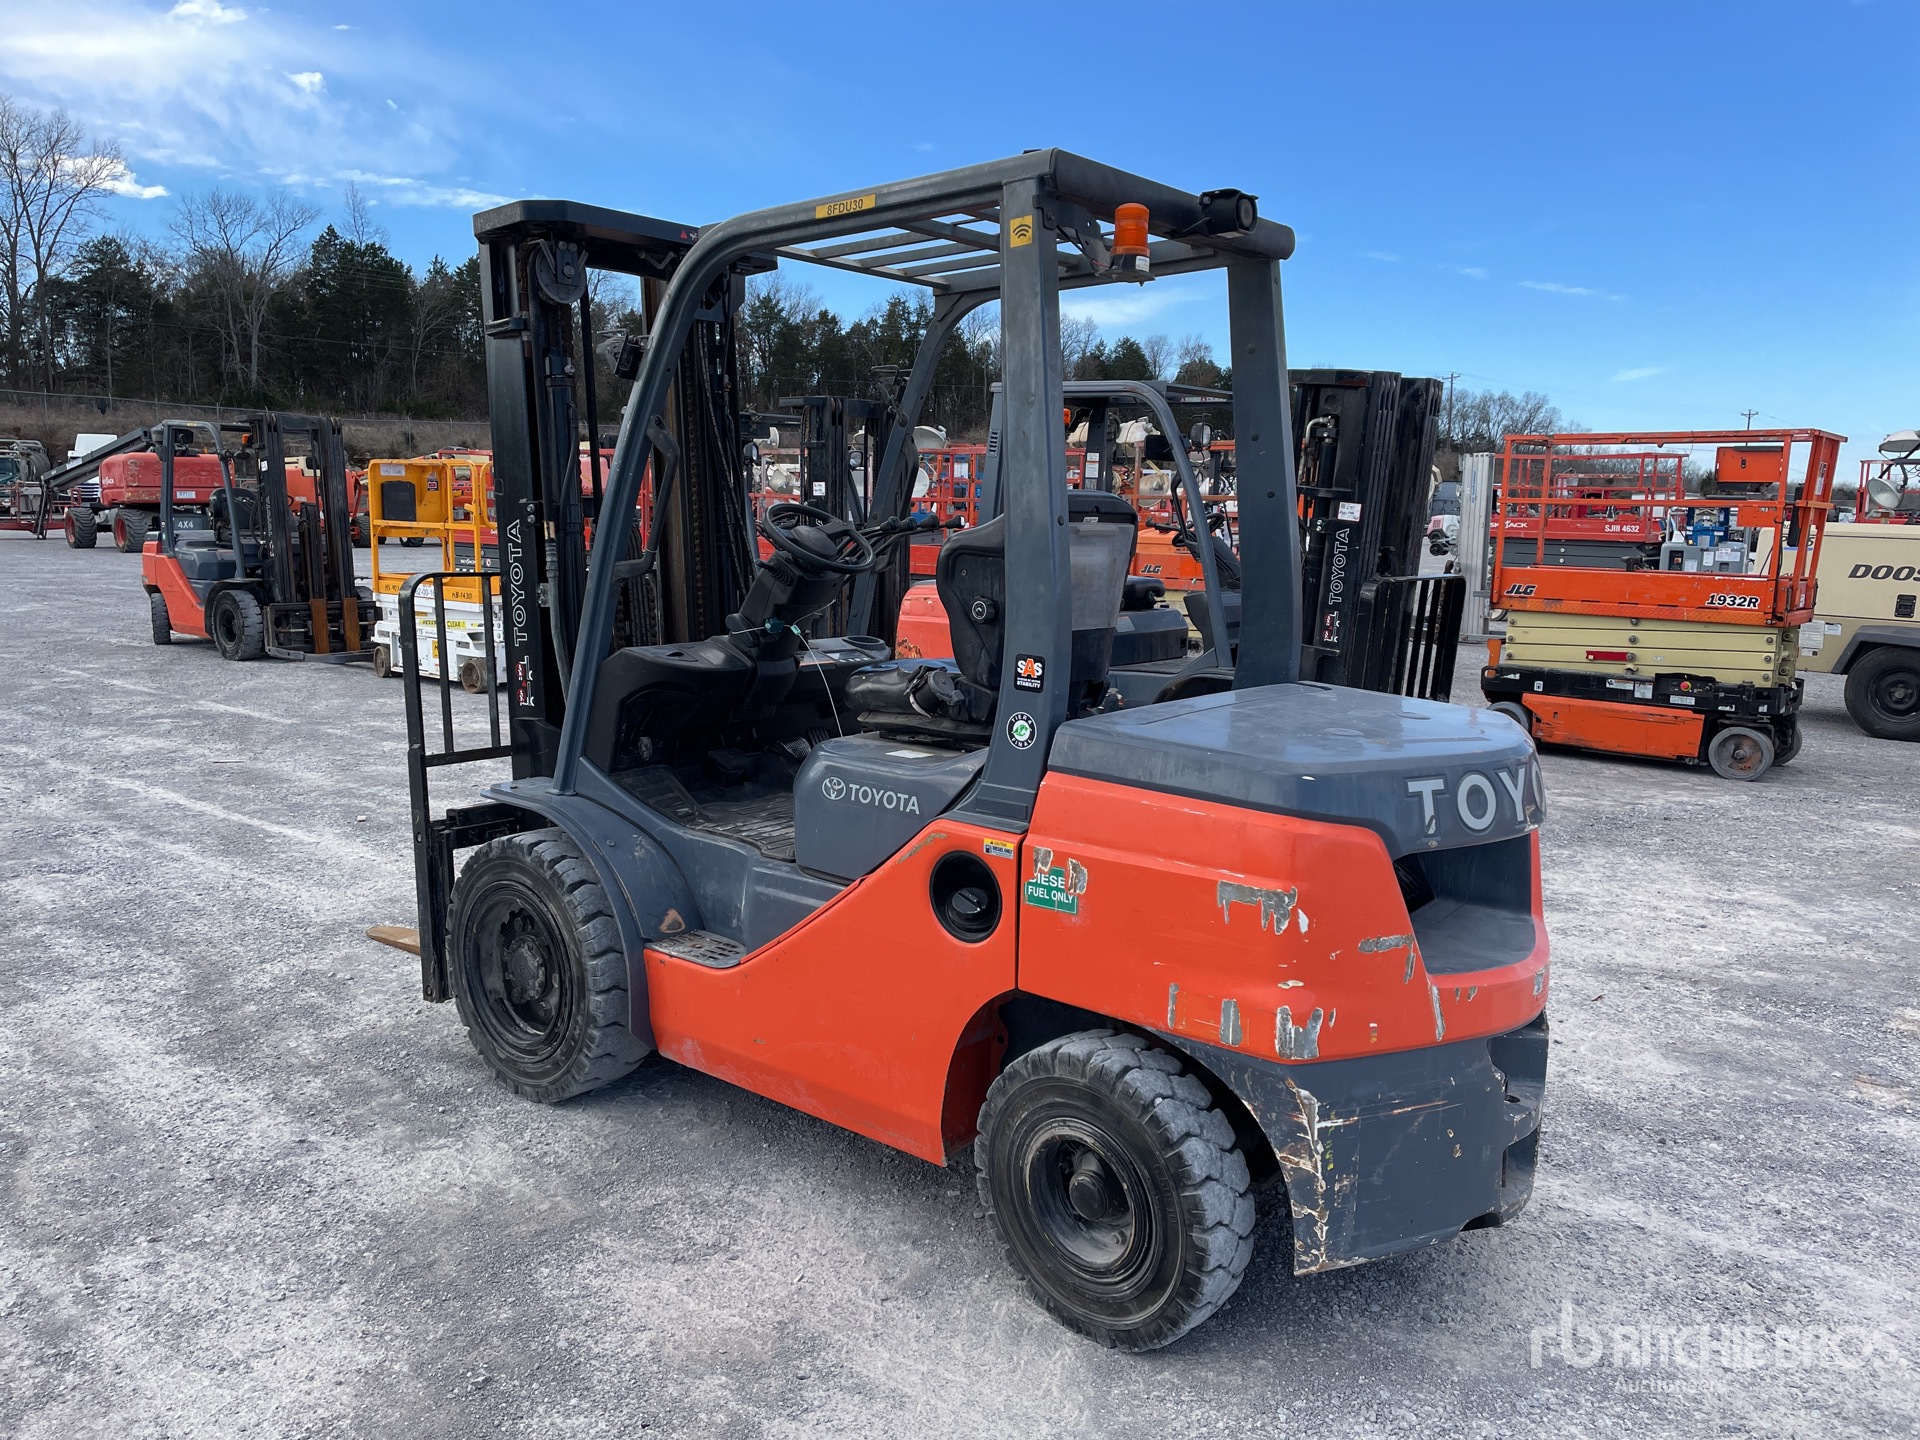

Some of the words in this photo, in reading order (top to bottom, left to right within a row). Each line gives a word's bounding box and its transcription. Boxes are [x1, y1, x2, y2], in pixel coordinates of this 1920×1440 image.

[826, 198, 864, 216] 8FDU30
[177, 520, 194, 529] 4X4
[1621, 524, 1640, 533] 4632
[1141, 563, 1162, 575] JLG
[1328, 527, 1350, 606] TOYOTA
[506, 518, 528, 647] TOYOTA
[1504, 583, 1539, 597] JLG
[1705, 592, 1760, 610] 1932R
[1016, 658, 1043, 679] SAS
[1011, 713, 1028, 723] TIER
[1011, 737, 1033, 748] FINAL
[848, 783, 920, 815] TOYOTA
[1028, 885, 1050, 900] FUEL
[1051, 890, 1074, 904] ONLY
